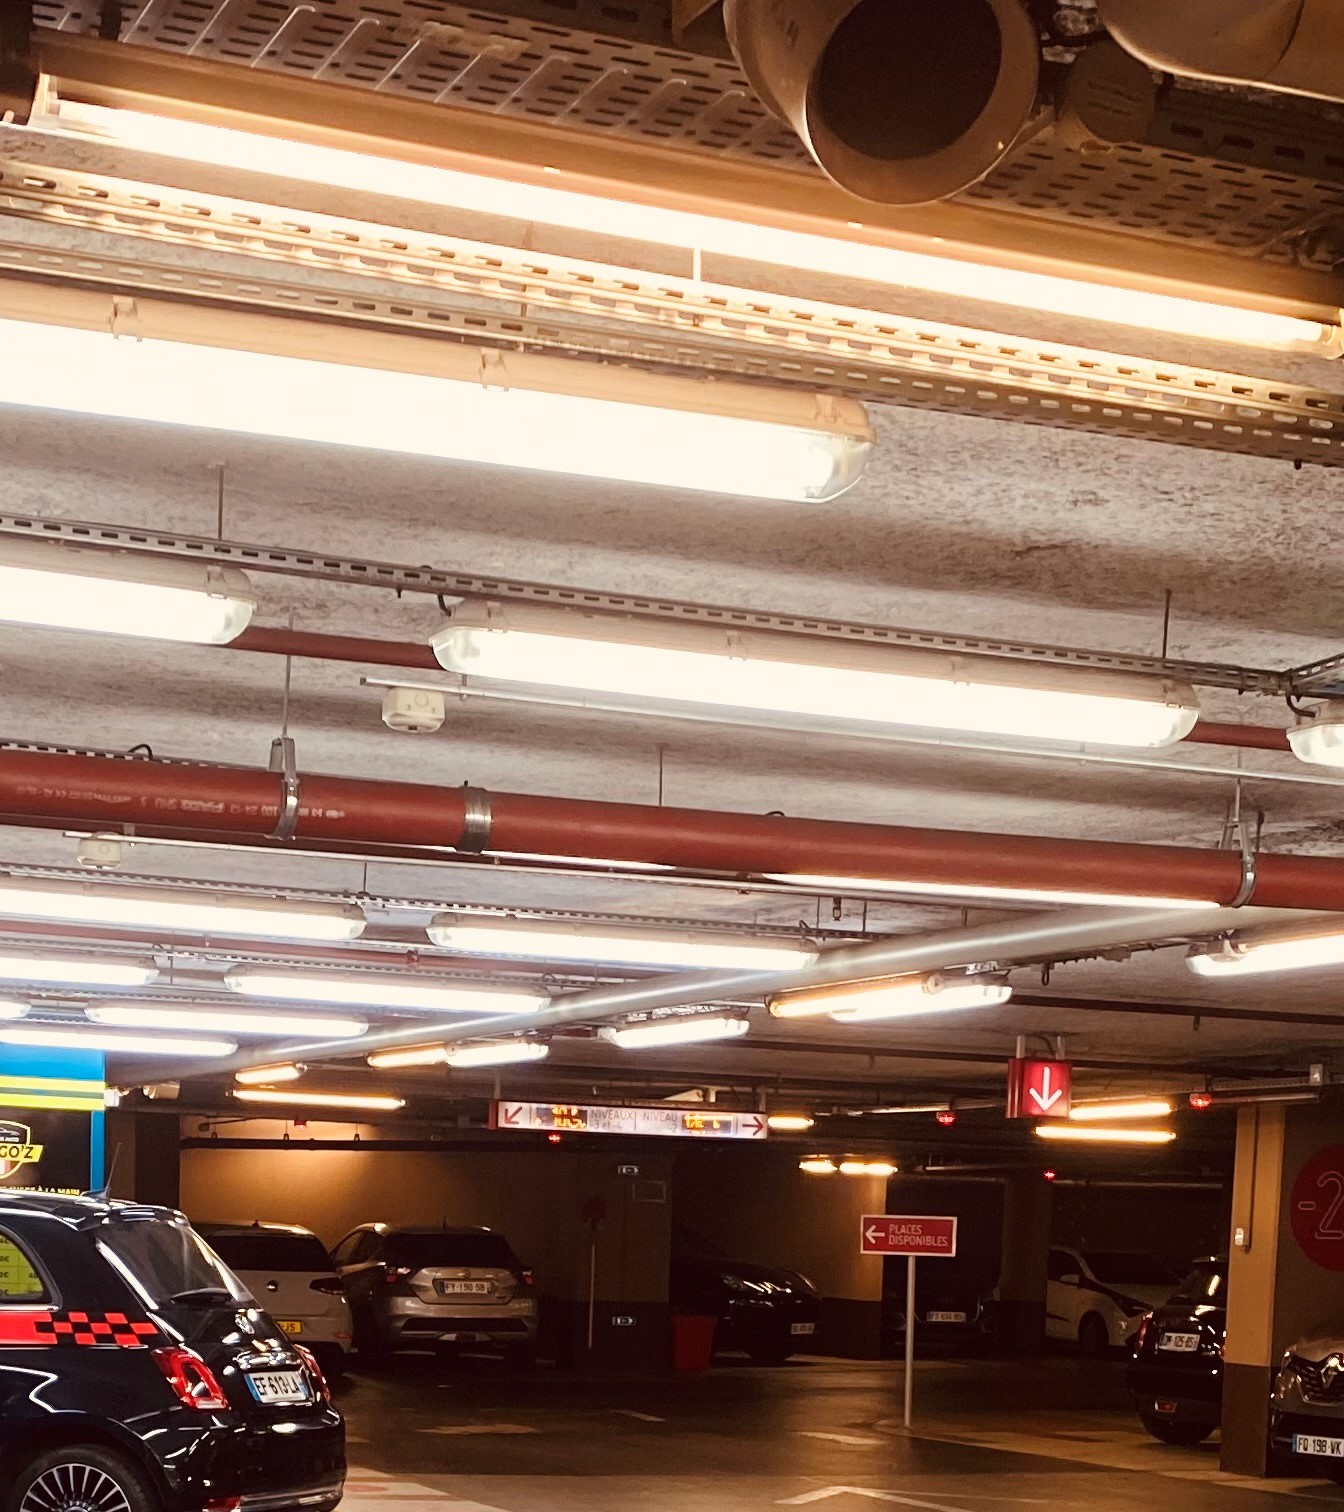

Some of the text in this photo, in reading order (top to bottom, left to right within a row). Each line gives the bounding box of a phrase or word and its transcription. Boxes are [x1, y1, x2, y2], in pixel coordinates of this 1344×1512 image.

[590, 1109, 634, 1121] NIVEAUX
[642, 1111, 678, 1122] NIVEAU
[888, 1223, 923, 1235] PLACES
[888, 1234, 949, 1247] DISPONIBLES
